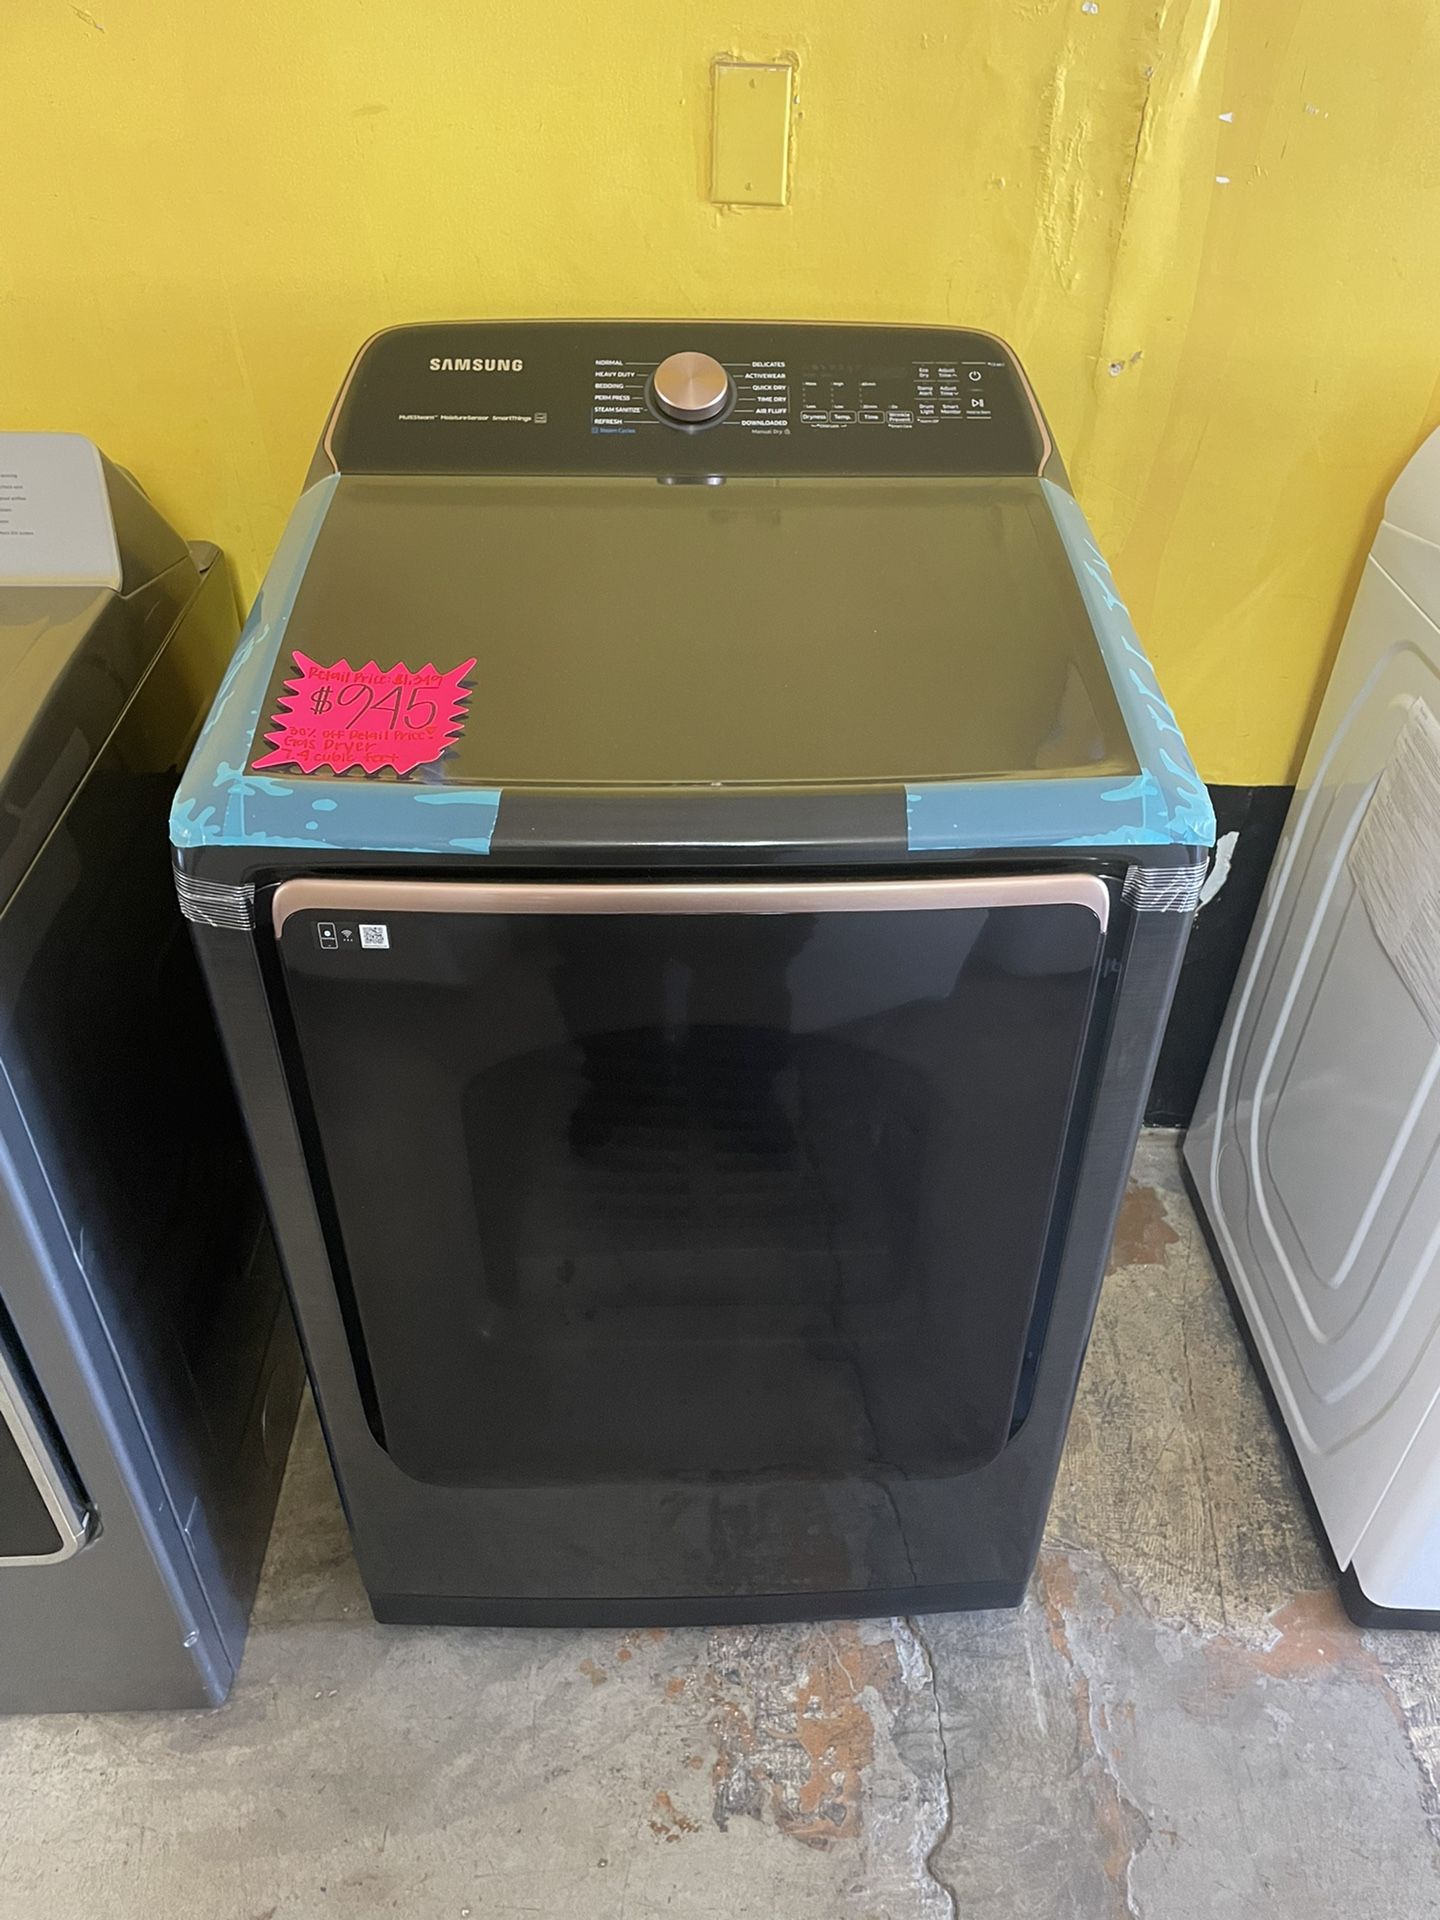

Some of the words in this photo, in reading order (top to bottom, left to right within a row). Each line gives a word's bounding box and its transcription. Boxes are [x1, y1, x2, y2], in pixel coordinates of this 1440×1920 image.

[429, 357, 524, 372] SAMSUNG
[594, 359, 624, 367] NORMAL
[751, 360, 786, 368] DELICATES
[594, 371, 617, 379] HEAVY
[594, 382, 625, 390] BEDDING
[594, 394, 612, 402] PERM
[612, 394, 631, 402] PRESS
[756, 395, 773, 403] TIME
[594, 418, 623, 426] REFRESH
[741, 419, 788, 427] DOWNLOADED
[307, 666, 350, 684] Retail
[309, 682, 441, 731] $945
[283, 736, 316, 750] Gas
[323, 739, 377, 755] Dryer
[312, 749, 357, 763] cubic
